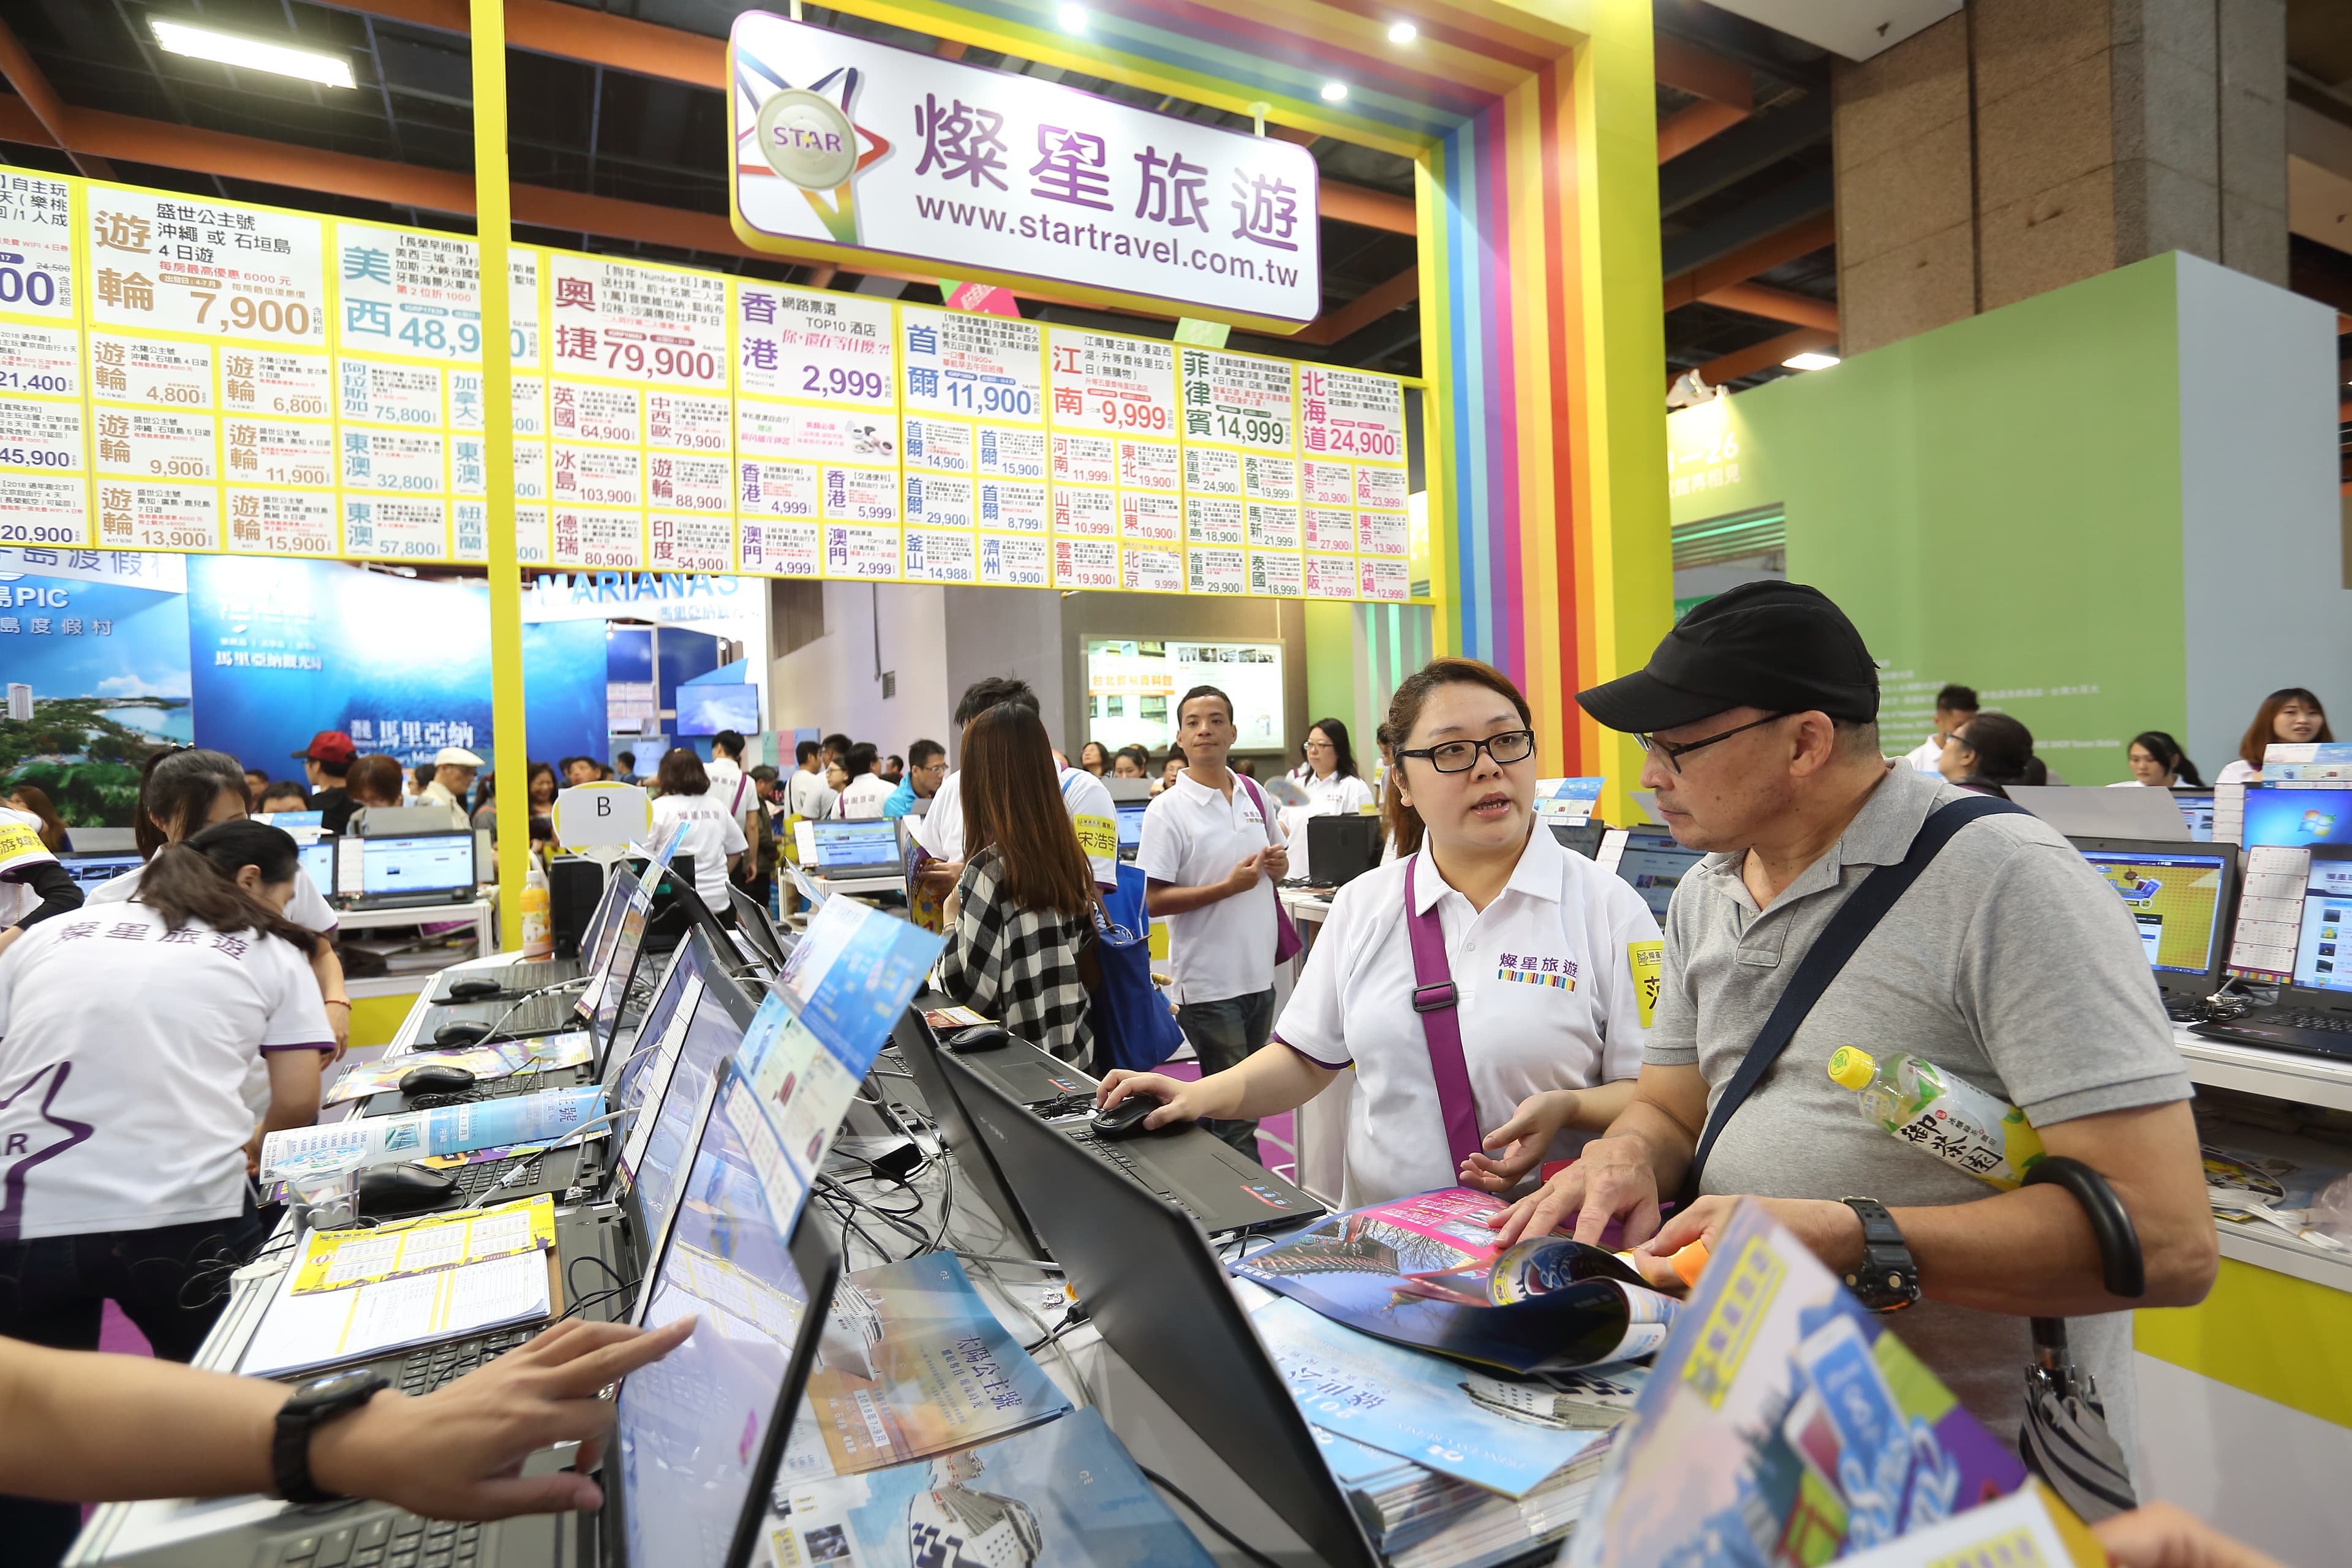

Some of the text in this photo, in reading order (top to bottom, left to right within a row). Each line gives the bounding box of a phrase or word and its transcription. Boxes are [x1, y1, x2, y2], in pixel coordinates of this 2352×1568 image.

[773, 125, 843, 154] STAR
[914, 93, 1298, 252] 燦星旅遊
[157, 203, 255, 231] 盛世公主號
[158, 224, 292, 255] 沖繩 或 石垣島
[915, 191, 1298, 288] www.startravel.com.tw
[95, 210, 154, 312] 遊輪
[159, 246, 214, 264] 4 日遊
[244, 273, 275, 284] 6000
[279, 275, 292, 286] 元
[343, 246, 392, 337] 美西
[447, 292, 471, 303] 1000
[782, 296, 837, 316] 網路票選
[190, 291, 309, 336] 7,900
[556, 277, 597, 361] 奧捷
[805, 317, 876, 337] TOP10 酒店
[741, 292, 778, 371] 香港
[94, 341, 127, 392] 遊輪
[604, 341, 714, 379] 79,900
[907, 324, 939, 398] 首爾
[227, 355, 255, 403] 遊輪
[342, 362, 368, 412] 阿拉斯加
[802, 364, 882, 398] 2,999
[1054, 345, 1082, 415] 江南
[1184, 350, 1212, 436] 菲律賓
[147, 385, 200, 405] 4,800
[273, 396, 323, 415] 6,800
[554, 386, 575, 428] 英國
[946, 381, 1031, 415] 11,900
[374, 405, 431, 423] 75,800
[651, 396, 671, 438] 中西歐
[1102, 400, 1165, 430] 9,999
[1302, 371, 1326, 451] 北海道
[99, 414, 130, 464] 遊輪
[581, 424, 630, 441] 64,900
[675, 433, 721, 448] 79,900
[907, 420, 923, 457] 首爾
[1217, 415, 1283, 444] 14,999
[1330, 429, 1394, 456] 24,900
[0, 448, 70, 467] 45,900
[230, 424, 258, 472] 遊輪
[345, 433, 371, 477] 東澳
[927, 454, 964, 470] 14,900
[981, 430, 997, 466] 首爾
[1054, 437, 1068, 473] 河南
[1121, 444, 1137, 478] 東北
[150, 459, 204, 479] 9,900
[266, 467, 325, 484] 11,900
[377, 473, 433, 490] 32,800
[555, 450, 576, 491] 冰島
[652, 458, 673, 499] 遊輪
[742, 464, 760, 503] 香港
[1001, 462, 1039, 476] 15,900
[1073, 469, 1108, 482] 11,999
[1139, 475, 1171, 488] 19,900
[580, 488, 631, 503] 103,900
[827, 470, 846, 508] 香港
[907, 477, 922, 514] 首爾
[1204, 481, 1235, 492] 24,900
[1261, 488, 1289, 499] 19,999
[102, 486, 134, 537] 遊輪
[676, 495, 722, 509] 88,900
[772, 501, 807, 514] 4,999
[858, 506, 892, 519] 5,999
[982, 484, 998, 520] 首爾
[1055, 491, 1070, 526] 山西
[1123, 496, 1139, 530] 山東
[232, 495, 261, 542] 遊輪
[347, 502, 373, 547] 東澳
[927, 512, 965, 526] 29,900
[1008, 517, 1038, 530] 8,799
[1074, 522, 1110, 535] 10,999
[1140, 527, 1172, 539] 10,900
[1, 525, 73, 543] 20,900
[141, 529, 207, 548] 13,900
[266, 535, 325, 552] 15,900
[379, 540, 435, 556] 57,800
[556, 514, 578, 556] 德瑞
[653, 521, 674, 560] 印度
[743, 526, 761, 564] 澳門
[829, 528, 847, 566] 澳門
[1206, 532, 1237, 543] 18,900
[1264, 535, 1293, 546] 21,999
[585, 552, 633, 567] 80,900
[678, 557, 723, 571] 54,900
[907, 534, 924, 570] 釜山
[984, 539, 1000, 575] 濟州
[1056, 541, 1072, 577] 雲南
[775, 562, 811, 575] 4,999
[858, 562, 891, 575] 2,999
[929, 567, 968, 581] 14,988
[1009, 571, 1040, 584] 9,900
[1077, 573, 1112, 586] 19,900
[1125, 551, 1139, 587] 北京
[537, 570, 739, 605] MARIANAS
[1155, 580, 1178, 589] 9,999
[1208, 582, 1240, 593] 29,900
[1268, 584, 1297, 595] 18,999
[597, 797, 611, 816] B
[1077, 831, 1116, 851] 宋浩宇
[1499, 952, 1578, 978] 燦星旅遊
[1899, 1114, 2003, 1174] 御茶園
[951, 1335, 1023, 1411] 太陽公主號
